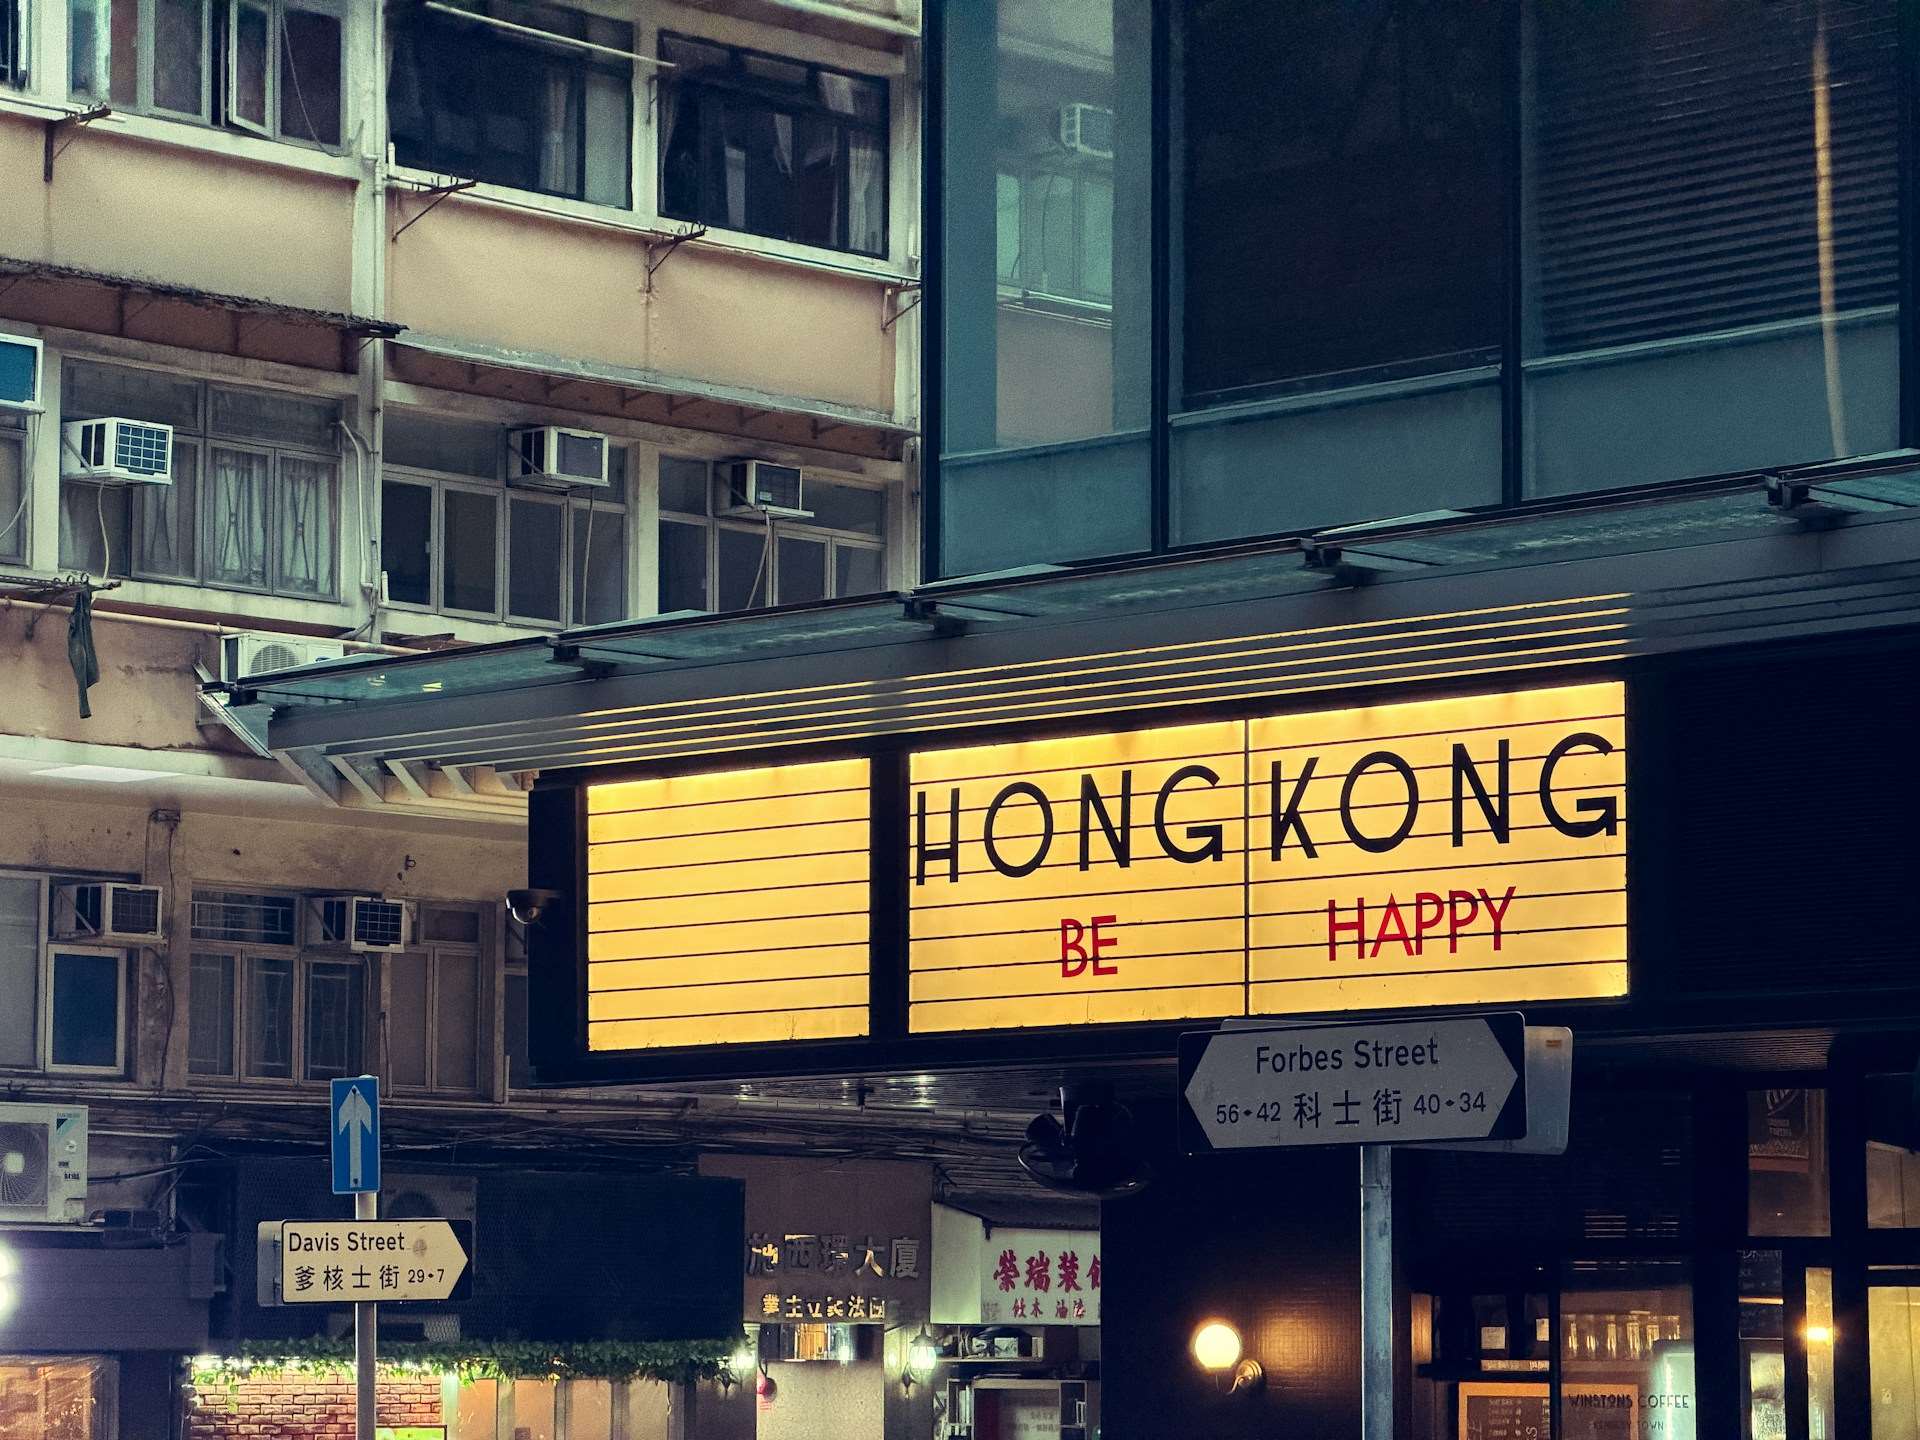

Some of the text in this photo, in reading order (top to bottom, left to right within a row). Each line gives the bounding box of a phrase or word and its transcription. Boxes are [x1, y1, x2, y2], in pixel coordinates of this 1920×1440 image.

[916, 732, 1617, 886] HONG KONG
[1060, 886, 1517, 978] BE HAPPY
[1255, 1036, 1439, 1074] Forbes Street
[1293, 1088, 1401, 1129] 科士街
[288, 1231, 405, 1252] Davis Street
[294, 1264, 400, 1292] 爹核士街
[1568, 1393, 1690, 1409] WINSTONS COFFEE
